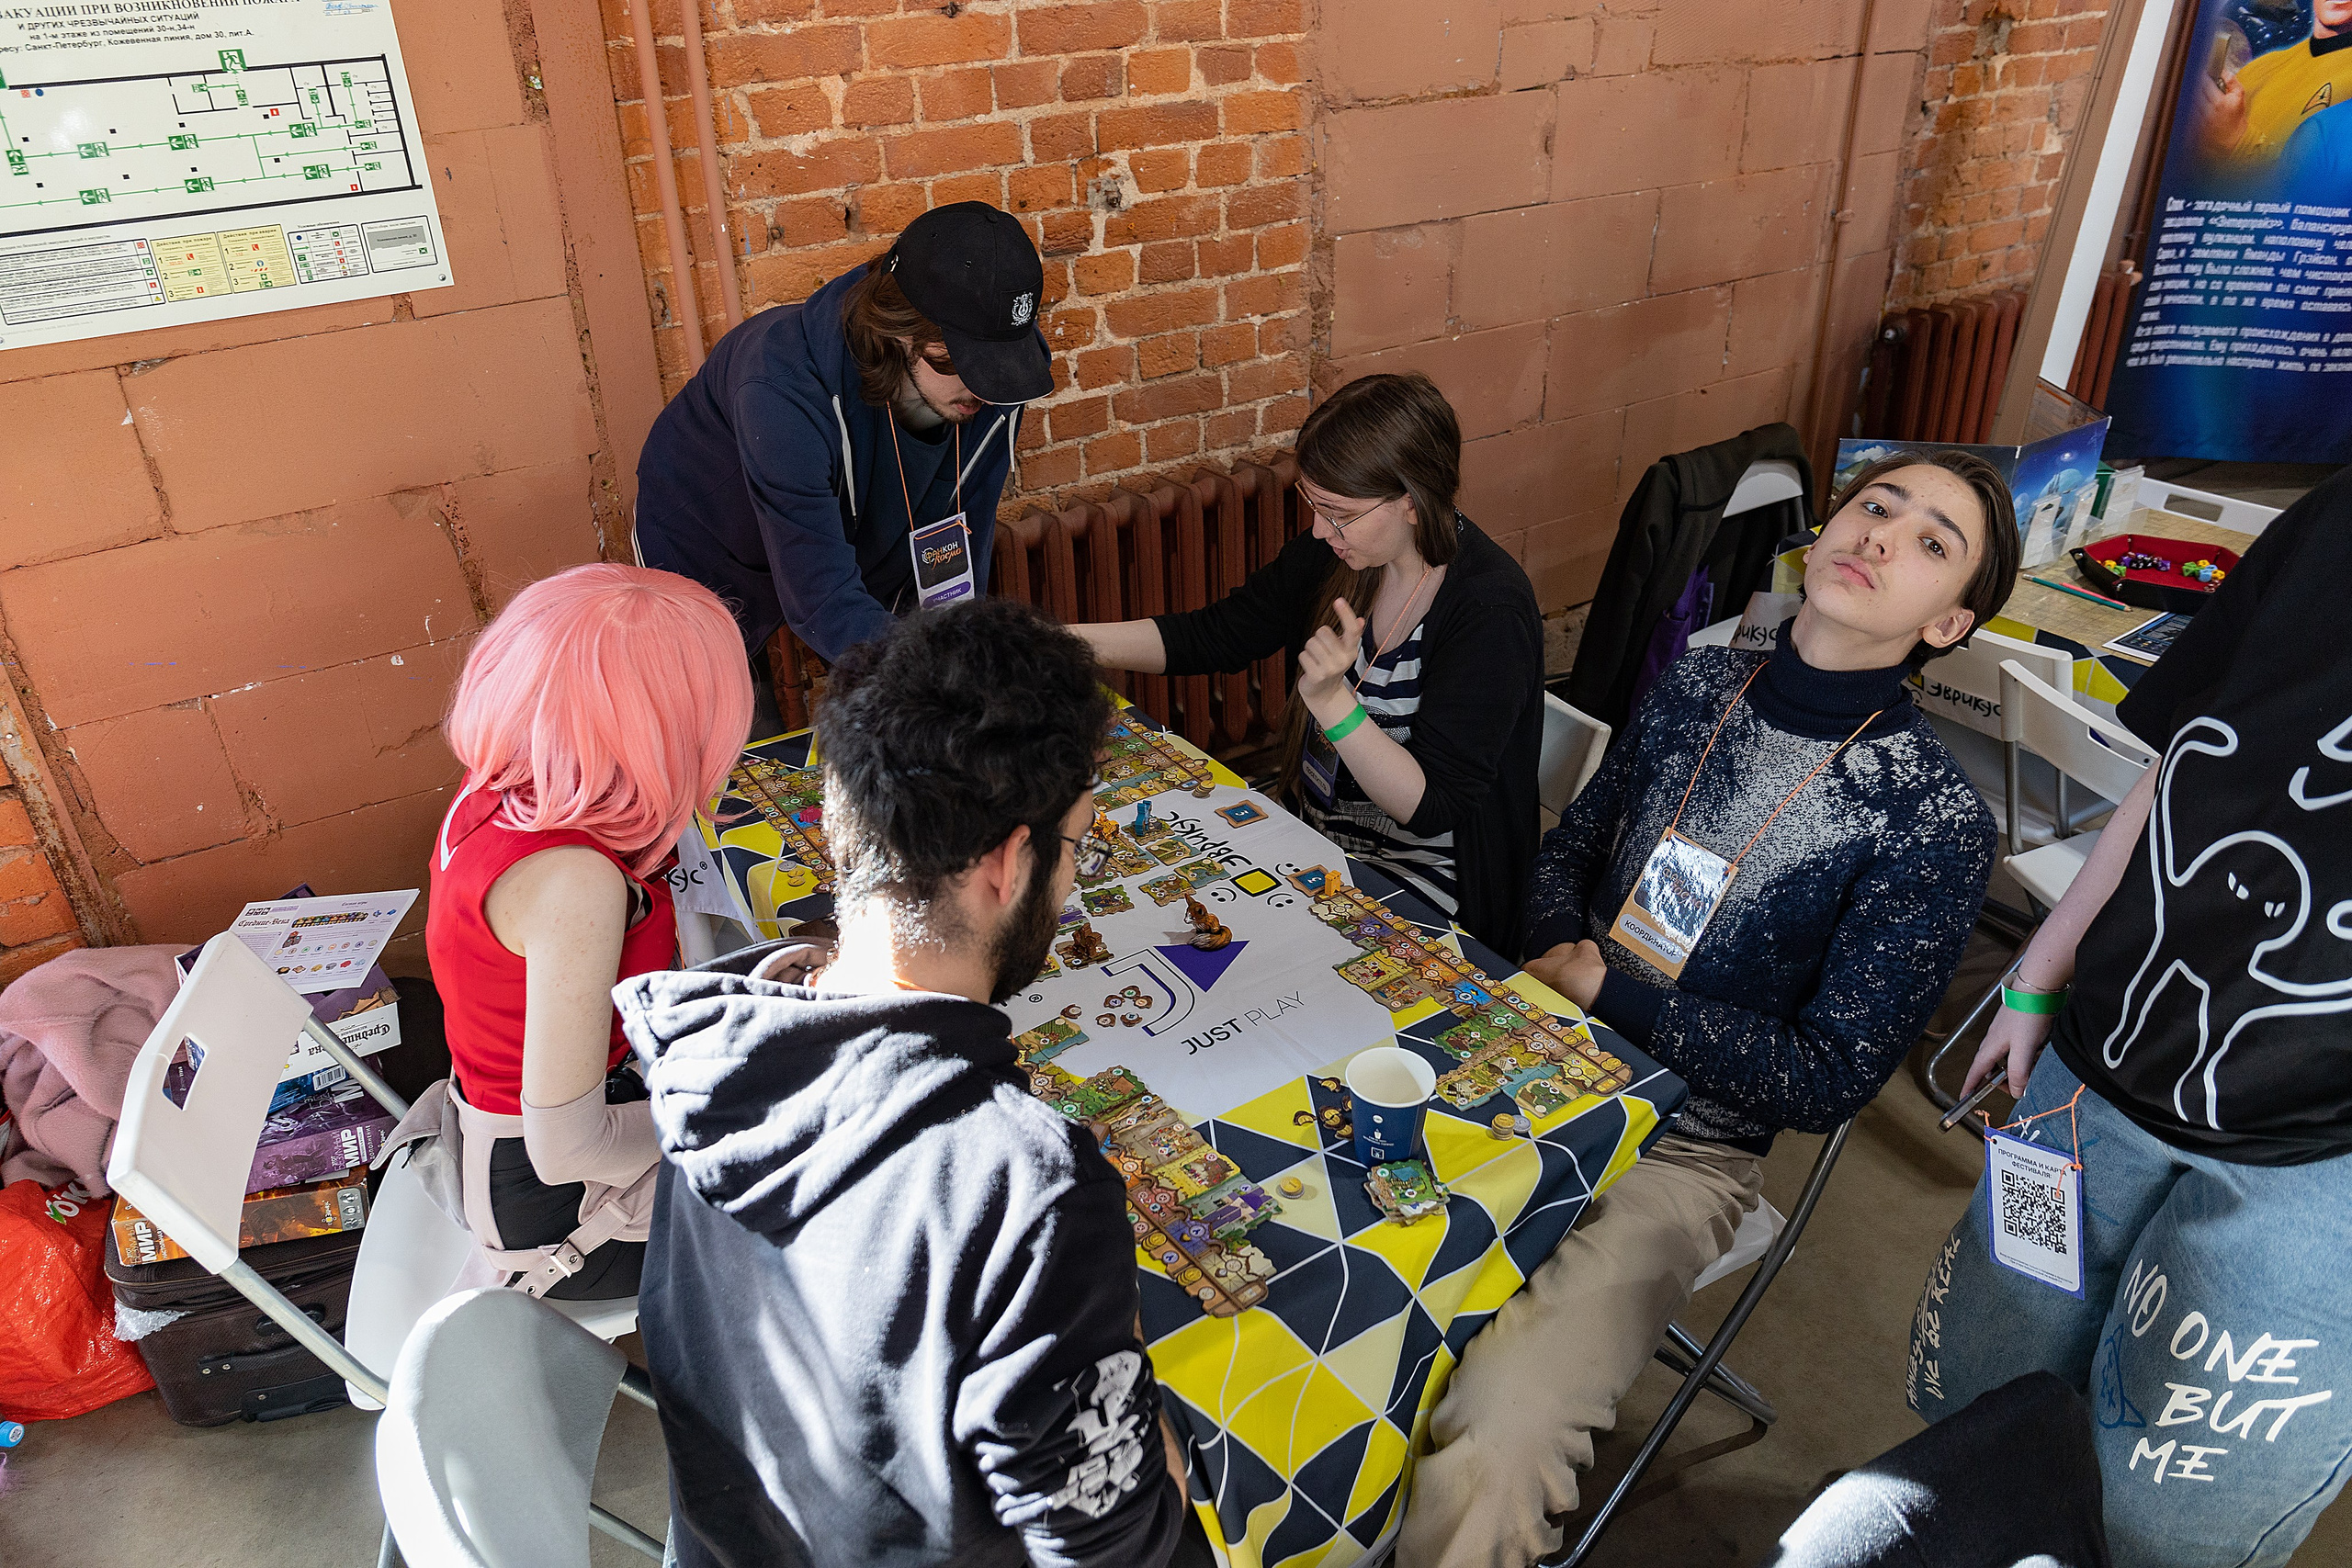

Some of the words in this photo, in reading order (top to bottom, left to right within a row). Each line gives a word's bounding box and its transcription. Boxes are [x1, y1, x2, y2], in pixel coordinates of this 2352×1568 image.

[28, 21, 65, 31] ДРУГИХ
[67, 16, 148, 28] ЧРЕЗВЫЧАЙНЫХ
[150, 11, 199, 23] СИТУАЦИЙ
[81, 4, 111, 16] ПРИ
[61, 31, 87, 39] этаже
[103, 26, 155, 37] помещений
[107, 36, 161, 46] Кожевенная
[2293, 204, 2351, 218] помощник
[1624, 919, 1679, 957] КООРДИНАТОР
[1181, 1018, 1246, 1056] JUST
[1243, 990, 1306, 1028] PLAY
[340, 1128, 360, 1169] МИР
[1997, 1148, 2038, 1168] ПРОГРАММА
[2011, 1160, 2052, 1179] ФЕСТИВАЛЯ:
[134, 1221, 158, 1262] МИР
[2124, 1258, 2167, 1337] NO
[2169, 1311, 2320, 1384] ONE
[2155, 1382, 2332, 1442] BUT
[2129, 1438, 2229, 1483] ME
